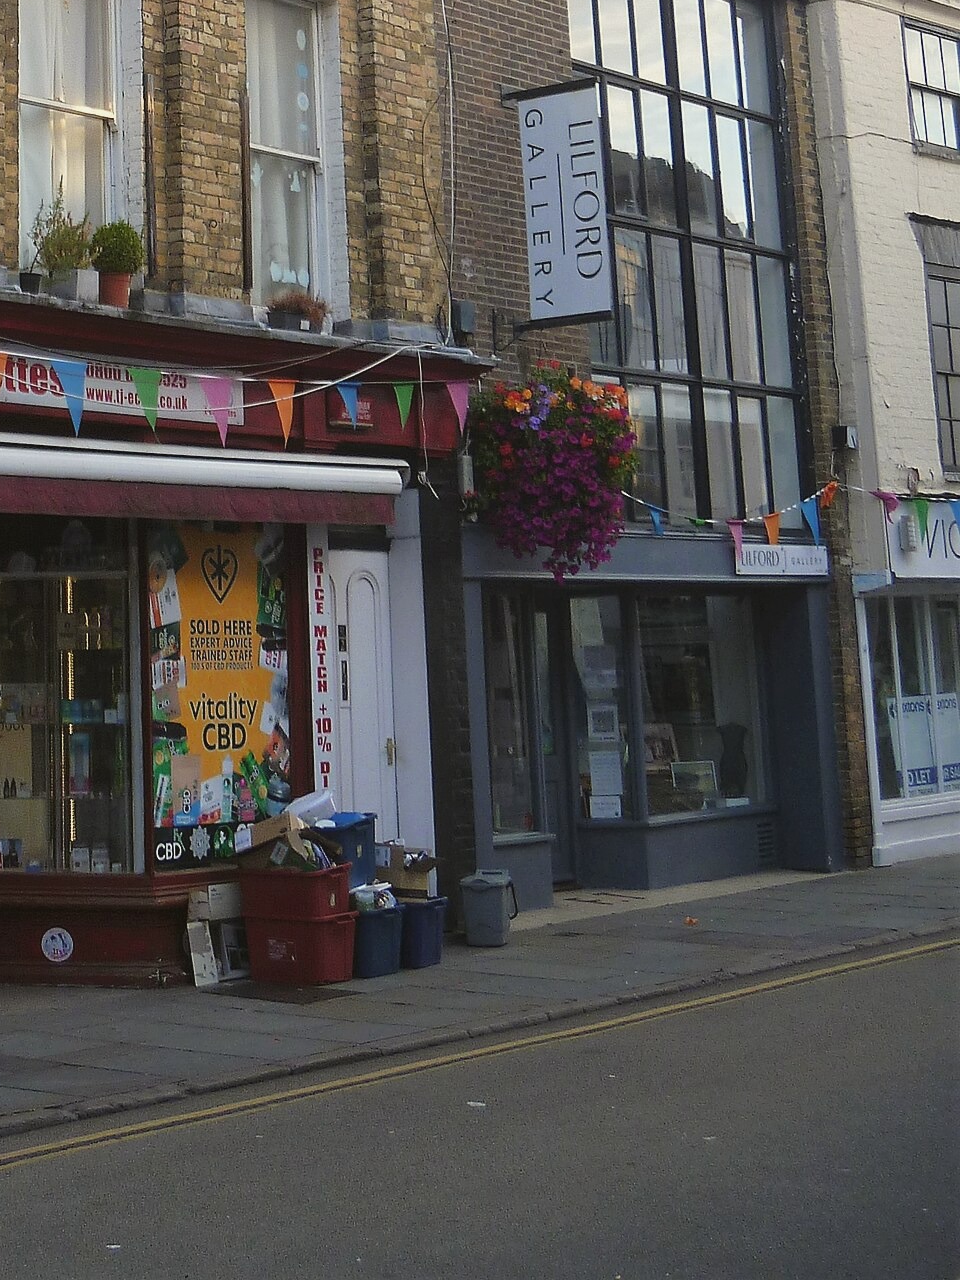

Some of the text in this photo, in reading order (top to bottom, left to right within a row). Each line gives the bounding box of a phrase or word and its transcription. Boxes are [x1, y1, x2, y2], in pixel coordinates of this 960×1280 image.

[524, 108, 554, 306] GALLERY
[568, 120, 603, 280] LILFORD
[741, 550, 822, 567] LILFORD GALLERY
[313, 547, 324, 615] PRICE
[190, 619, 252, 636] SOLD HERE
[190, 637, 252, 648] EXPERT ADVICE
[191, 649, 252, 661] TRAINED STAFF
[314, 625, 328, 693] MATCH
[189, 693, 257, 725] vitality
[202, 723, 247, 751] CBD
[915, 769, 931, 785] LET
[156, 842, 182, 861] CBD
